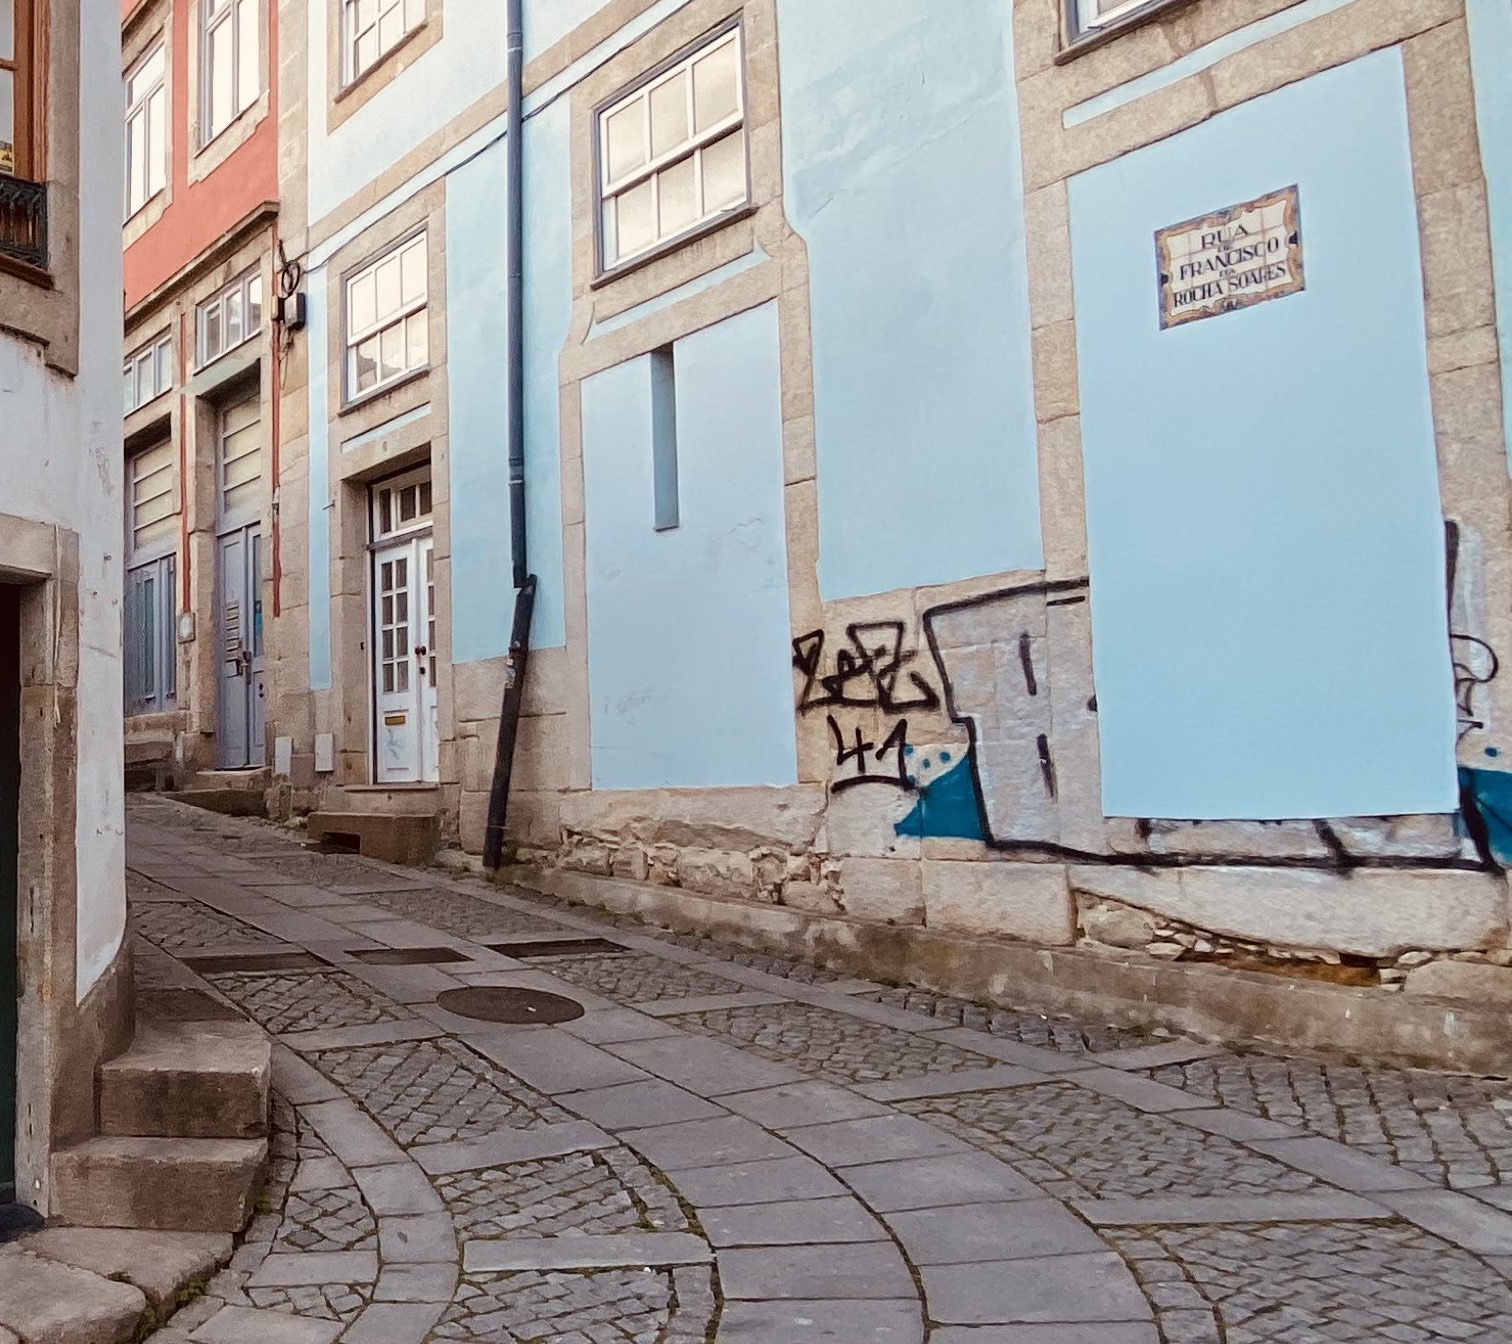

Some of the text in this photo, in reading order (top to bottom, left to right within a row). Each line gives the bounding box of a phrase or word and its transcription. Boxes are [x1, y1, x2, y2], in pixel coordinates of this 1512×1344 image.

[1201, 224, 1248, 249] RUA
[1179, 237, 1279, 280] FRANCISCO
[1173, 261, 1286, 308] ROCHA SOARES
